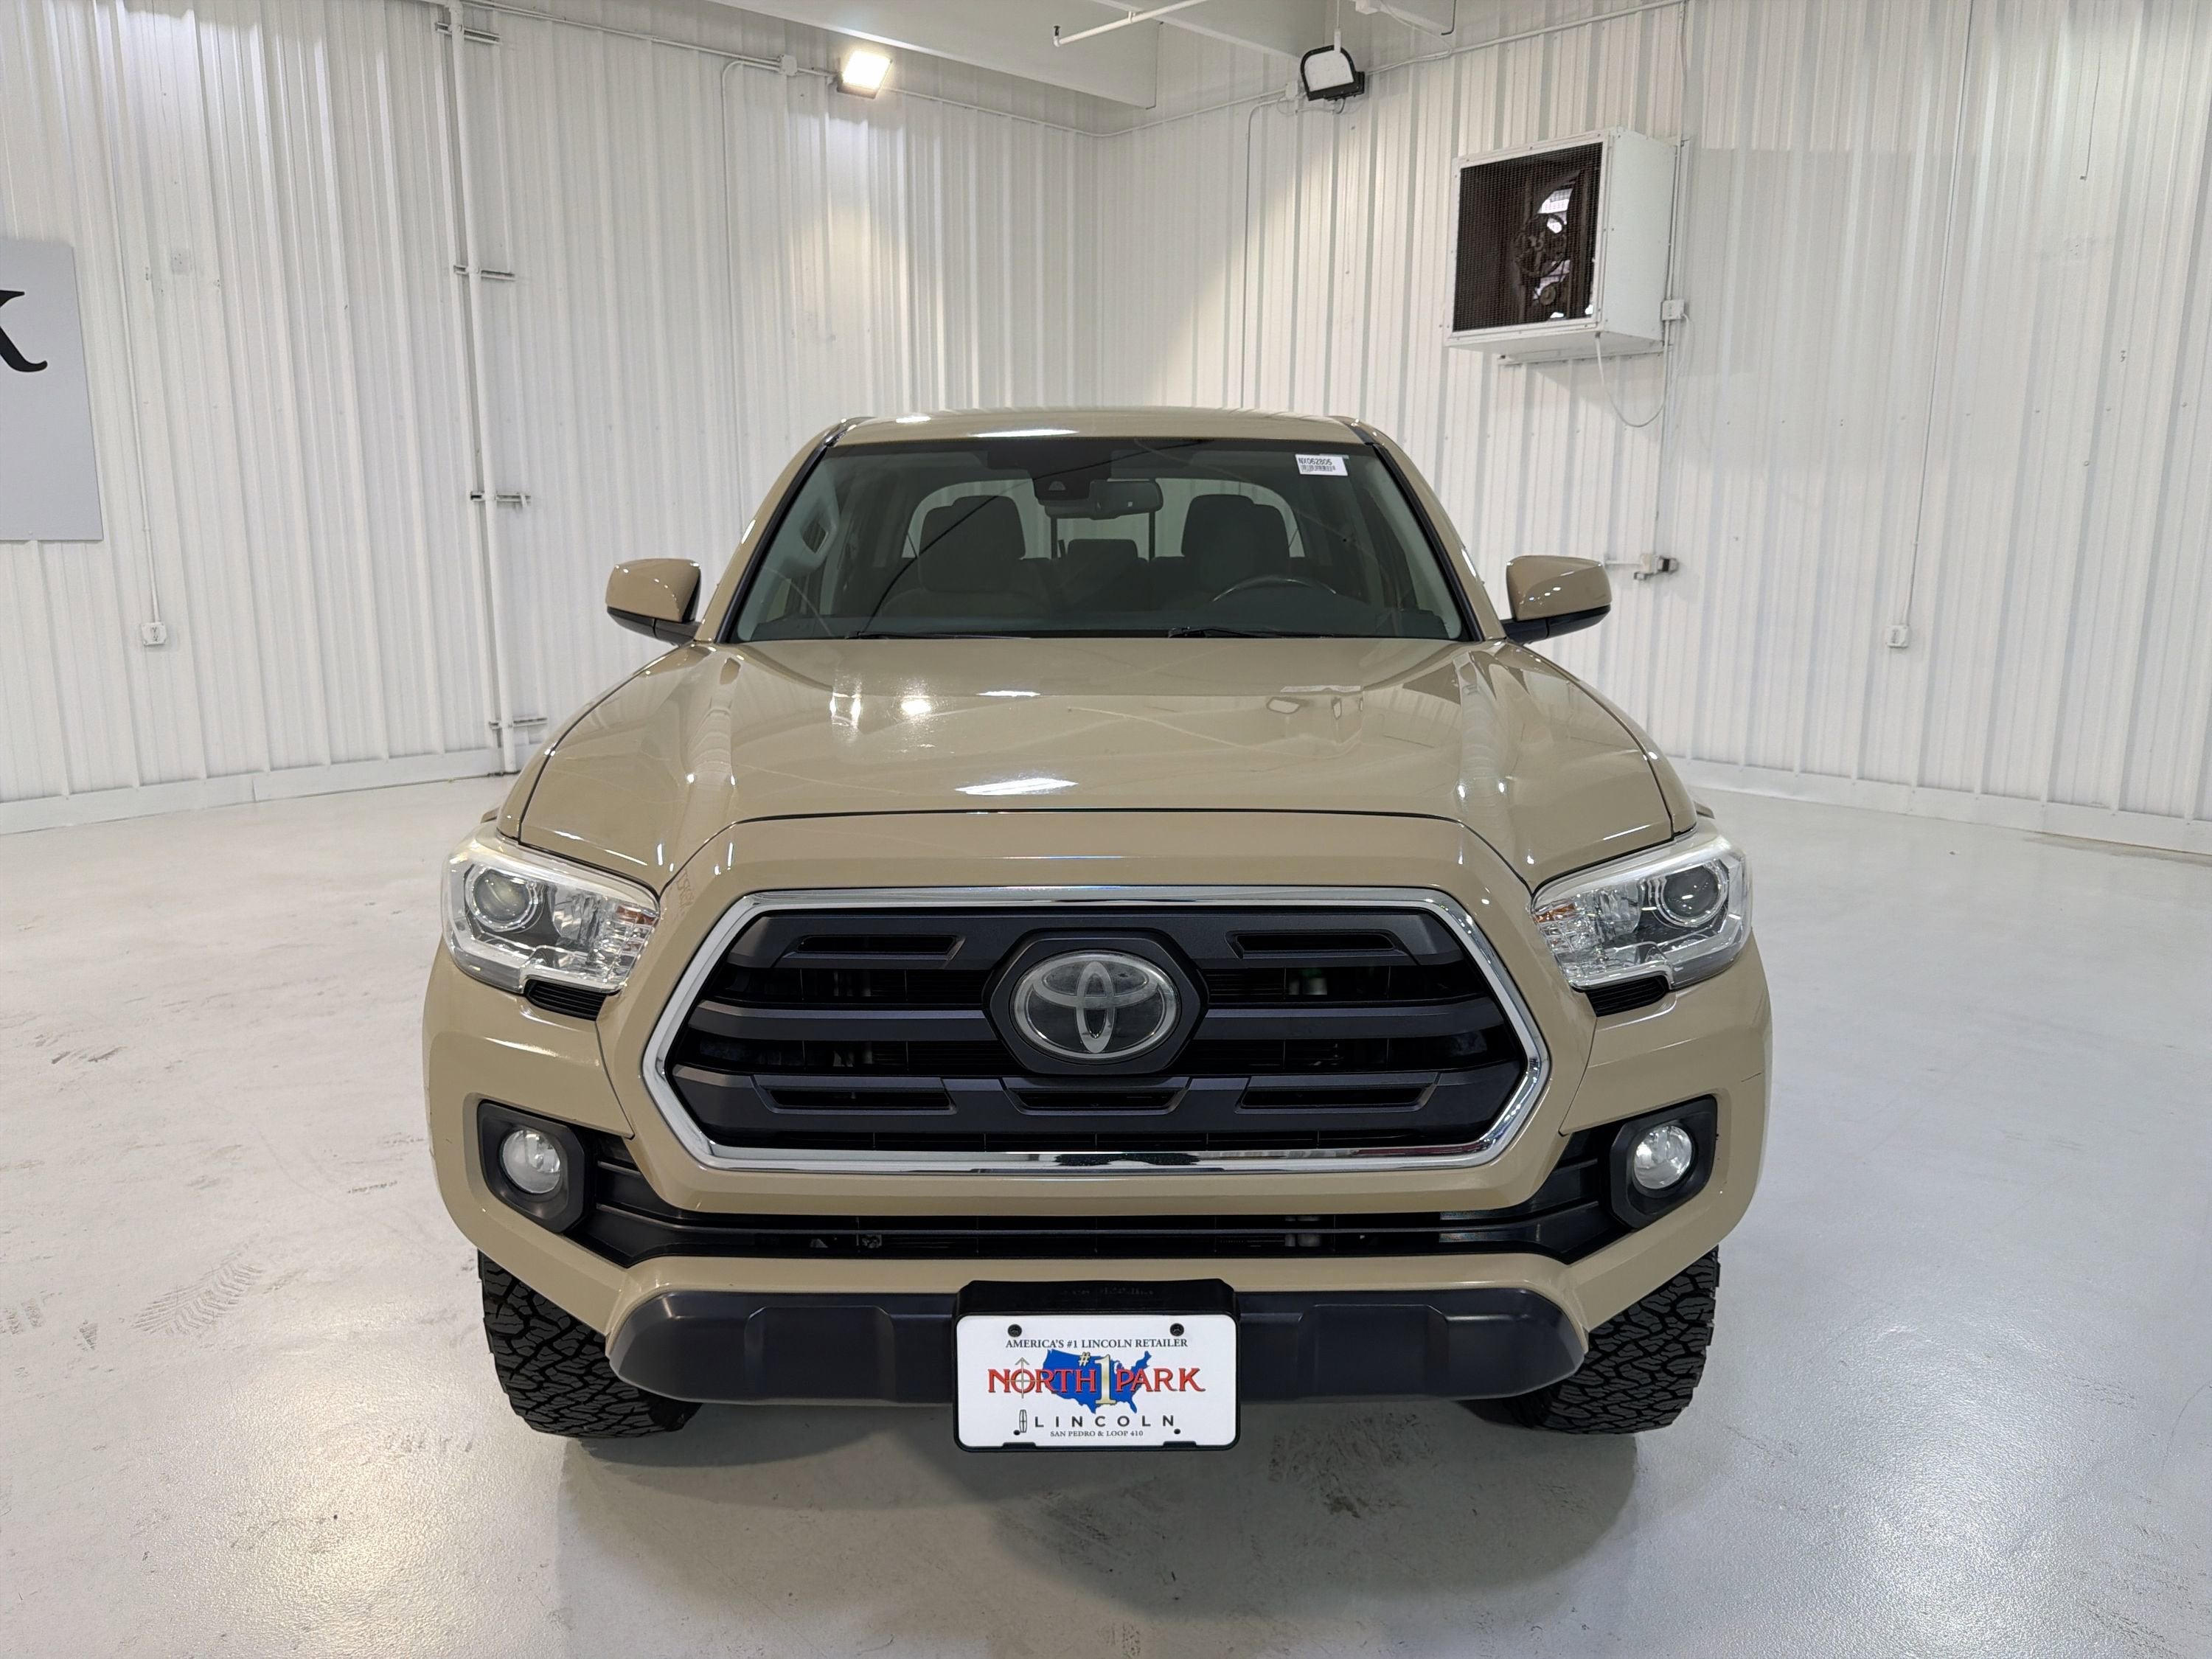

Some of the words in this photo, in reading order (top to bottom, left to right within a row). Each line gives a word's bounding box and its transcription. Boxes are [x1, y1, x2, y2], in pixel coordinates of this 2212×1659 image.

[1006, 1339, 1065, 1349] AMERICA'S
[1066, 1340, 1078, 1349] #1
[1082, 1339, 1133, 1349] LINCOLN
[1135, 1338, 1189, 1348] RETAILER
[988, 1368, 1097, 1394] NORTH
[1115, 1368, 1206, 1393] PARK
[1034, 1415, 1175, 1428] LINCOLN
